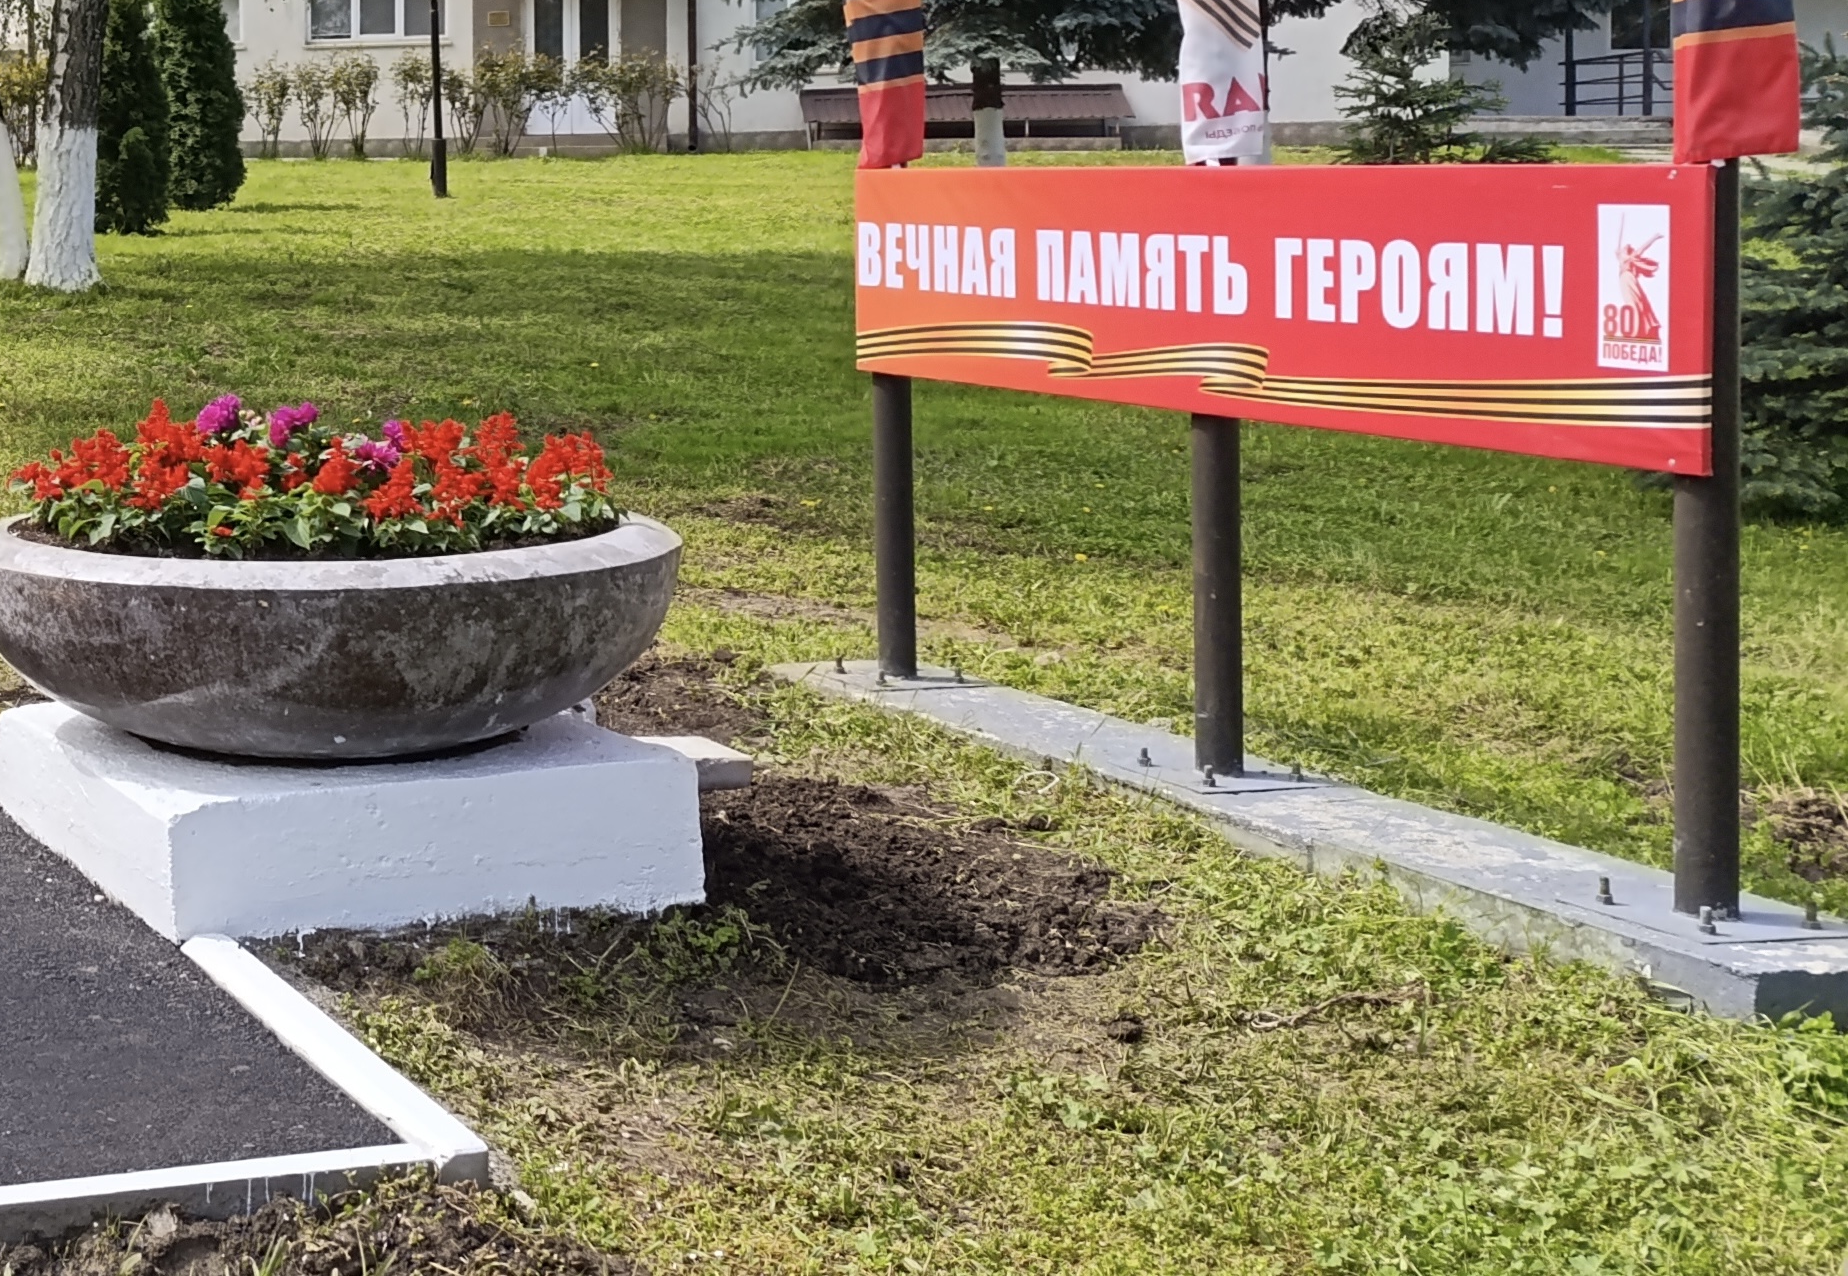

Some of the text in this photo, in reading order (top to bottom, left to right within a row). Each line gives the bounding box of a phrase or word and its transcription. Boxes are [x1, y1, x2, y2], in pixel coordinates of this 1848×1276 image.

[857, 221, 1565, 339] ВЕЧНАЯ ПАМЯТЬ ГЕРОЯМ!
[1602, 303, 1636, 338] 80
[1602, 342, 1663, 365] ПОБЕДА!
